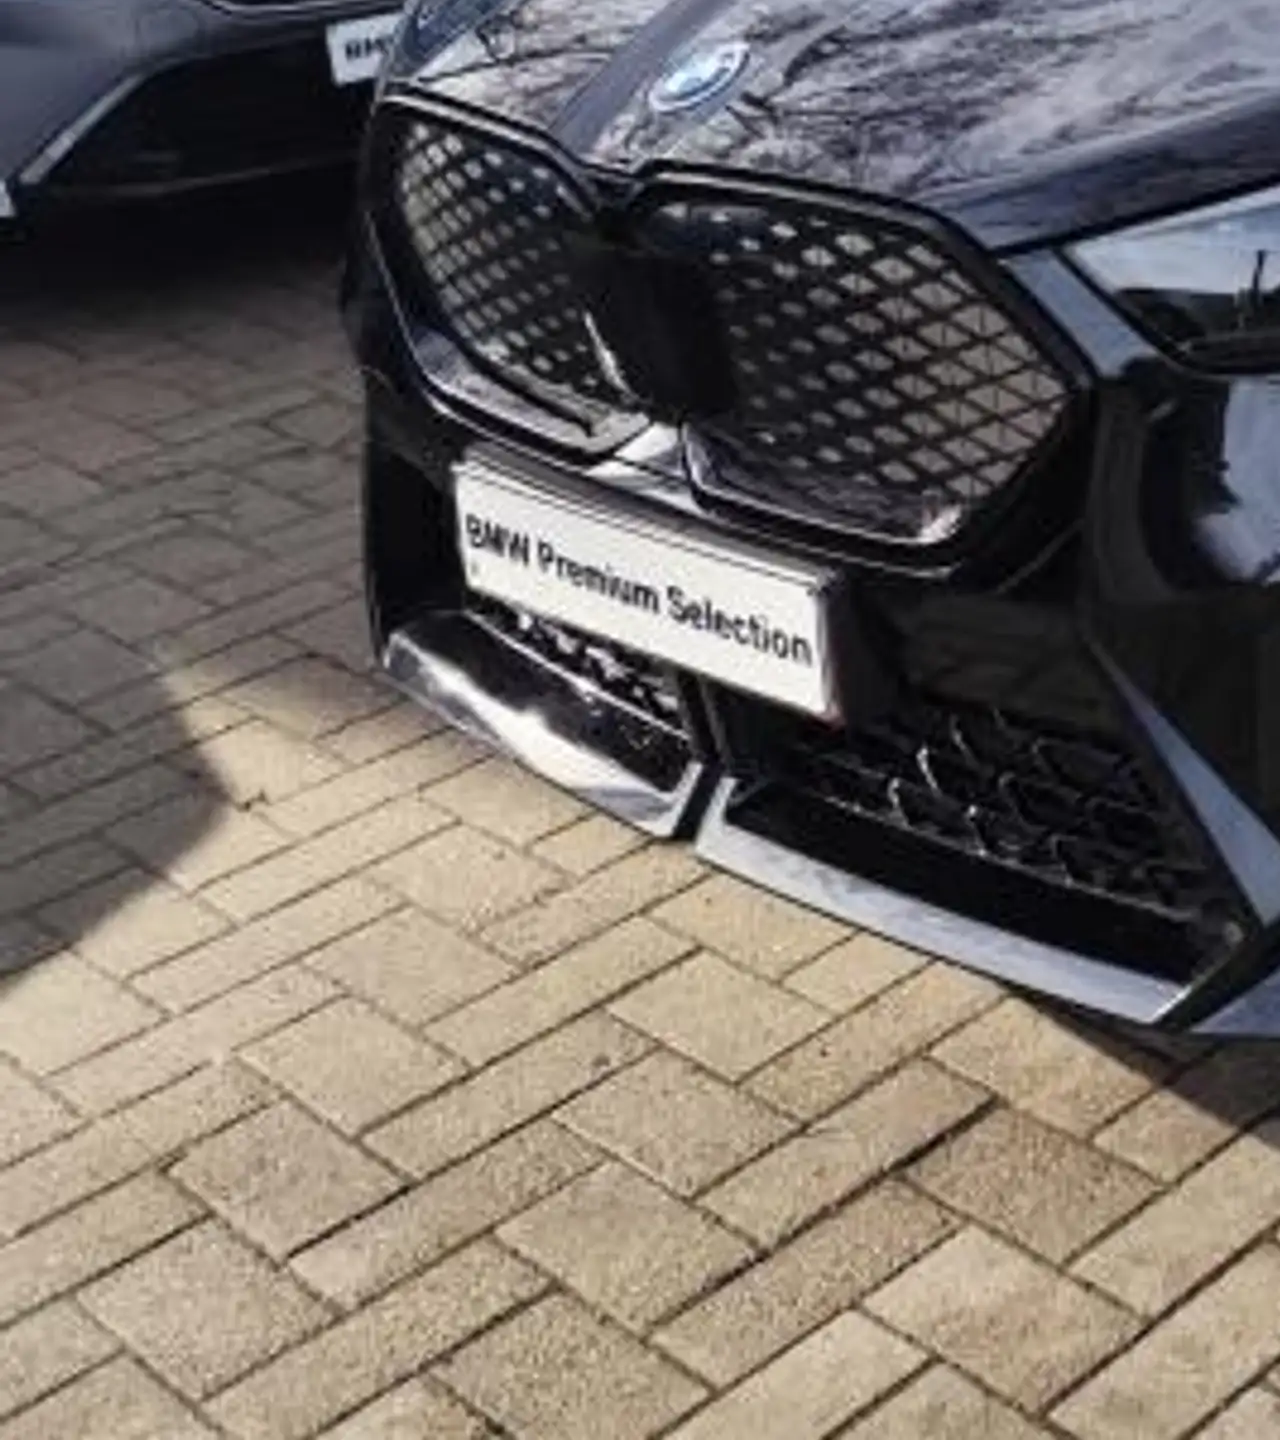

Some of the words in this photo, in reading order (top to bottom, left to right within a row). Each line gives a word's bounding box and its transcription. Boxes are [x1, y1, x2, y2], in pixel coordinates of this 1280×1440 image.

[465, 513, 530, 568] BMW
[537, 540, 660, 616] Premium
[667, 584, 813, 667] Selection
